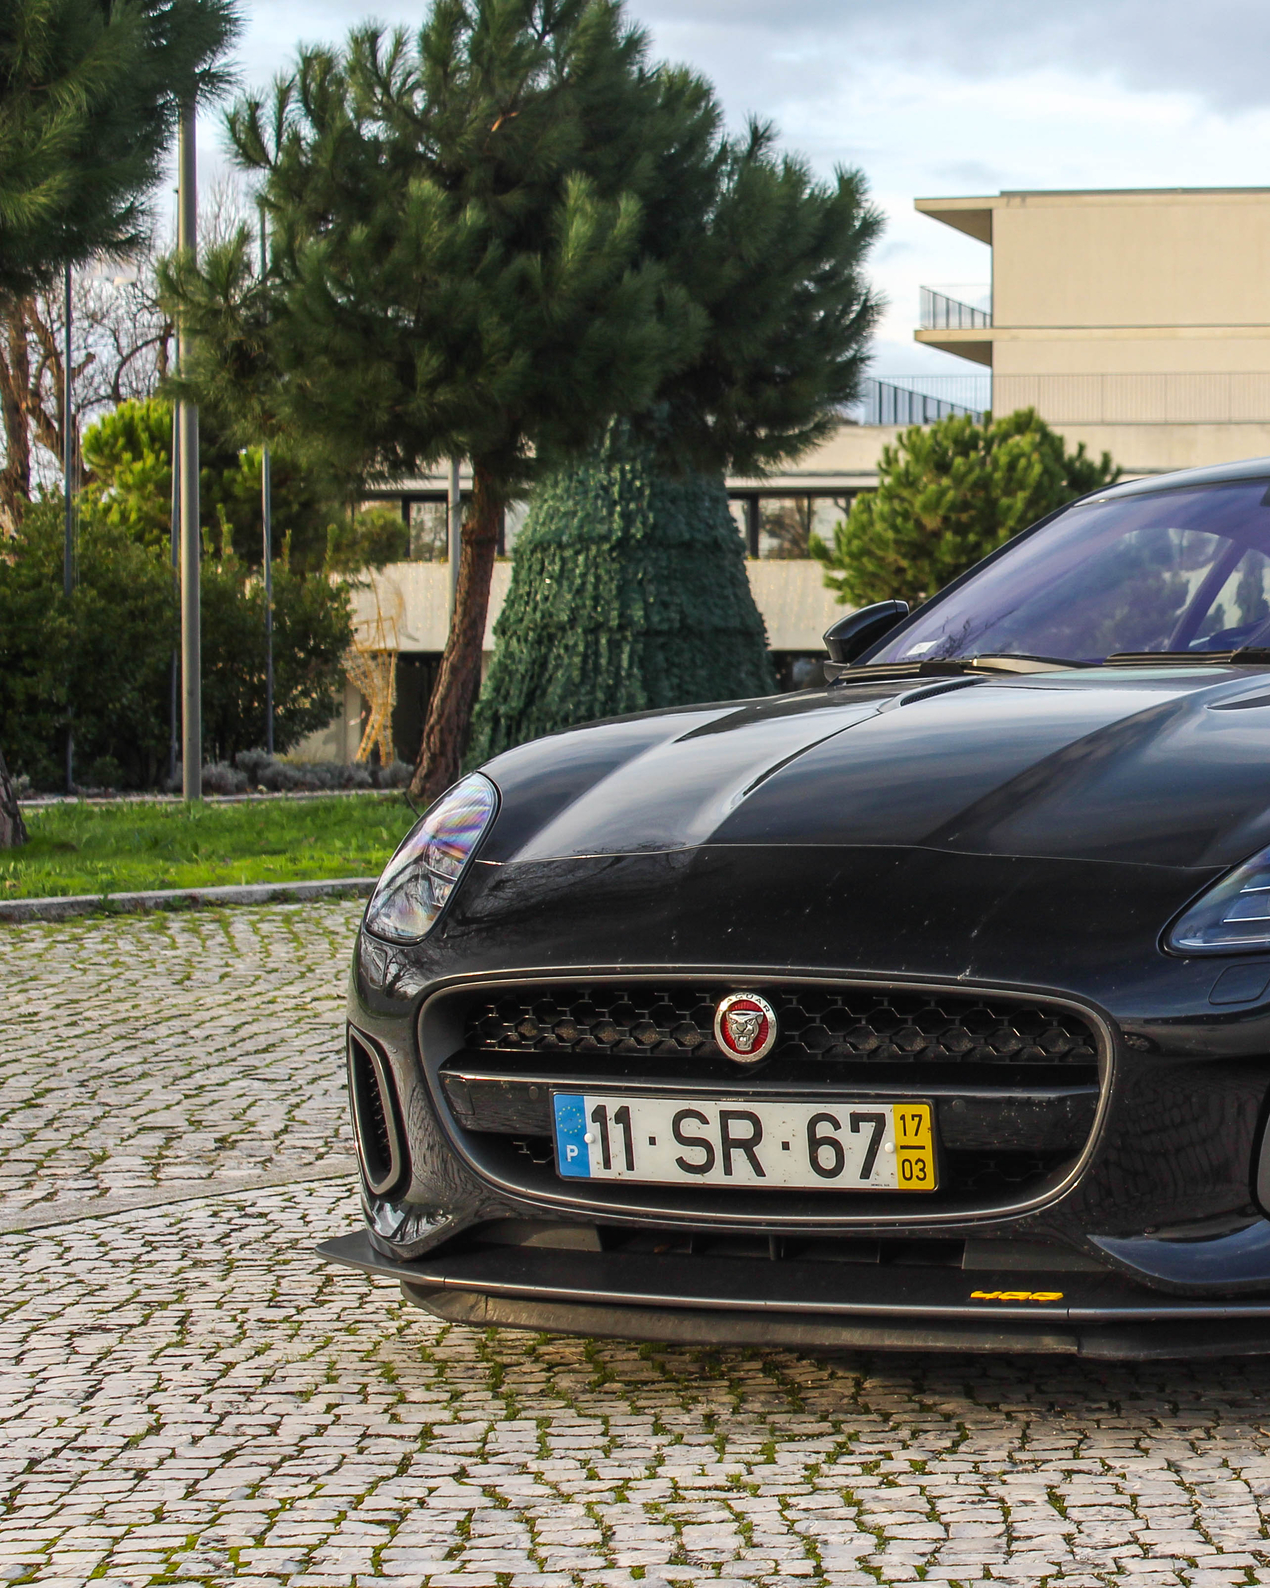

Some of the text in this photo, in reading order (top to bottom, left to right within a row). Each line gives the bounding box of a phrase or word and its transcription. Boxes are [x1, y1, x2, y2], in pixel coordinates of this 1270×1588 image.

[720, 991, 771, 1013] AGUAR
[899, 1113, 923, 1137] 17
[566, 1144, 579, 1162] P
[901, 1157, 927, 1181] 03
